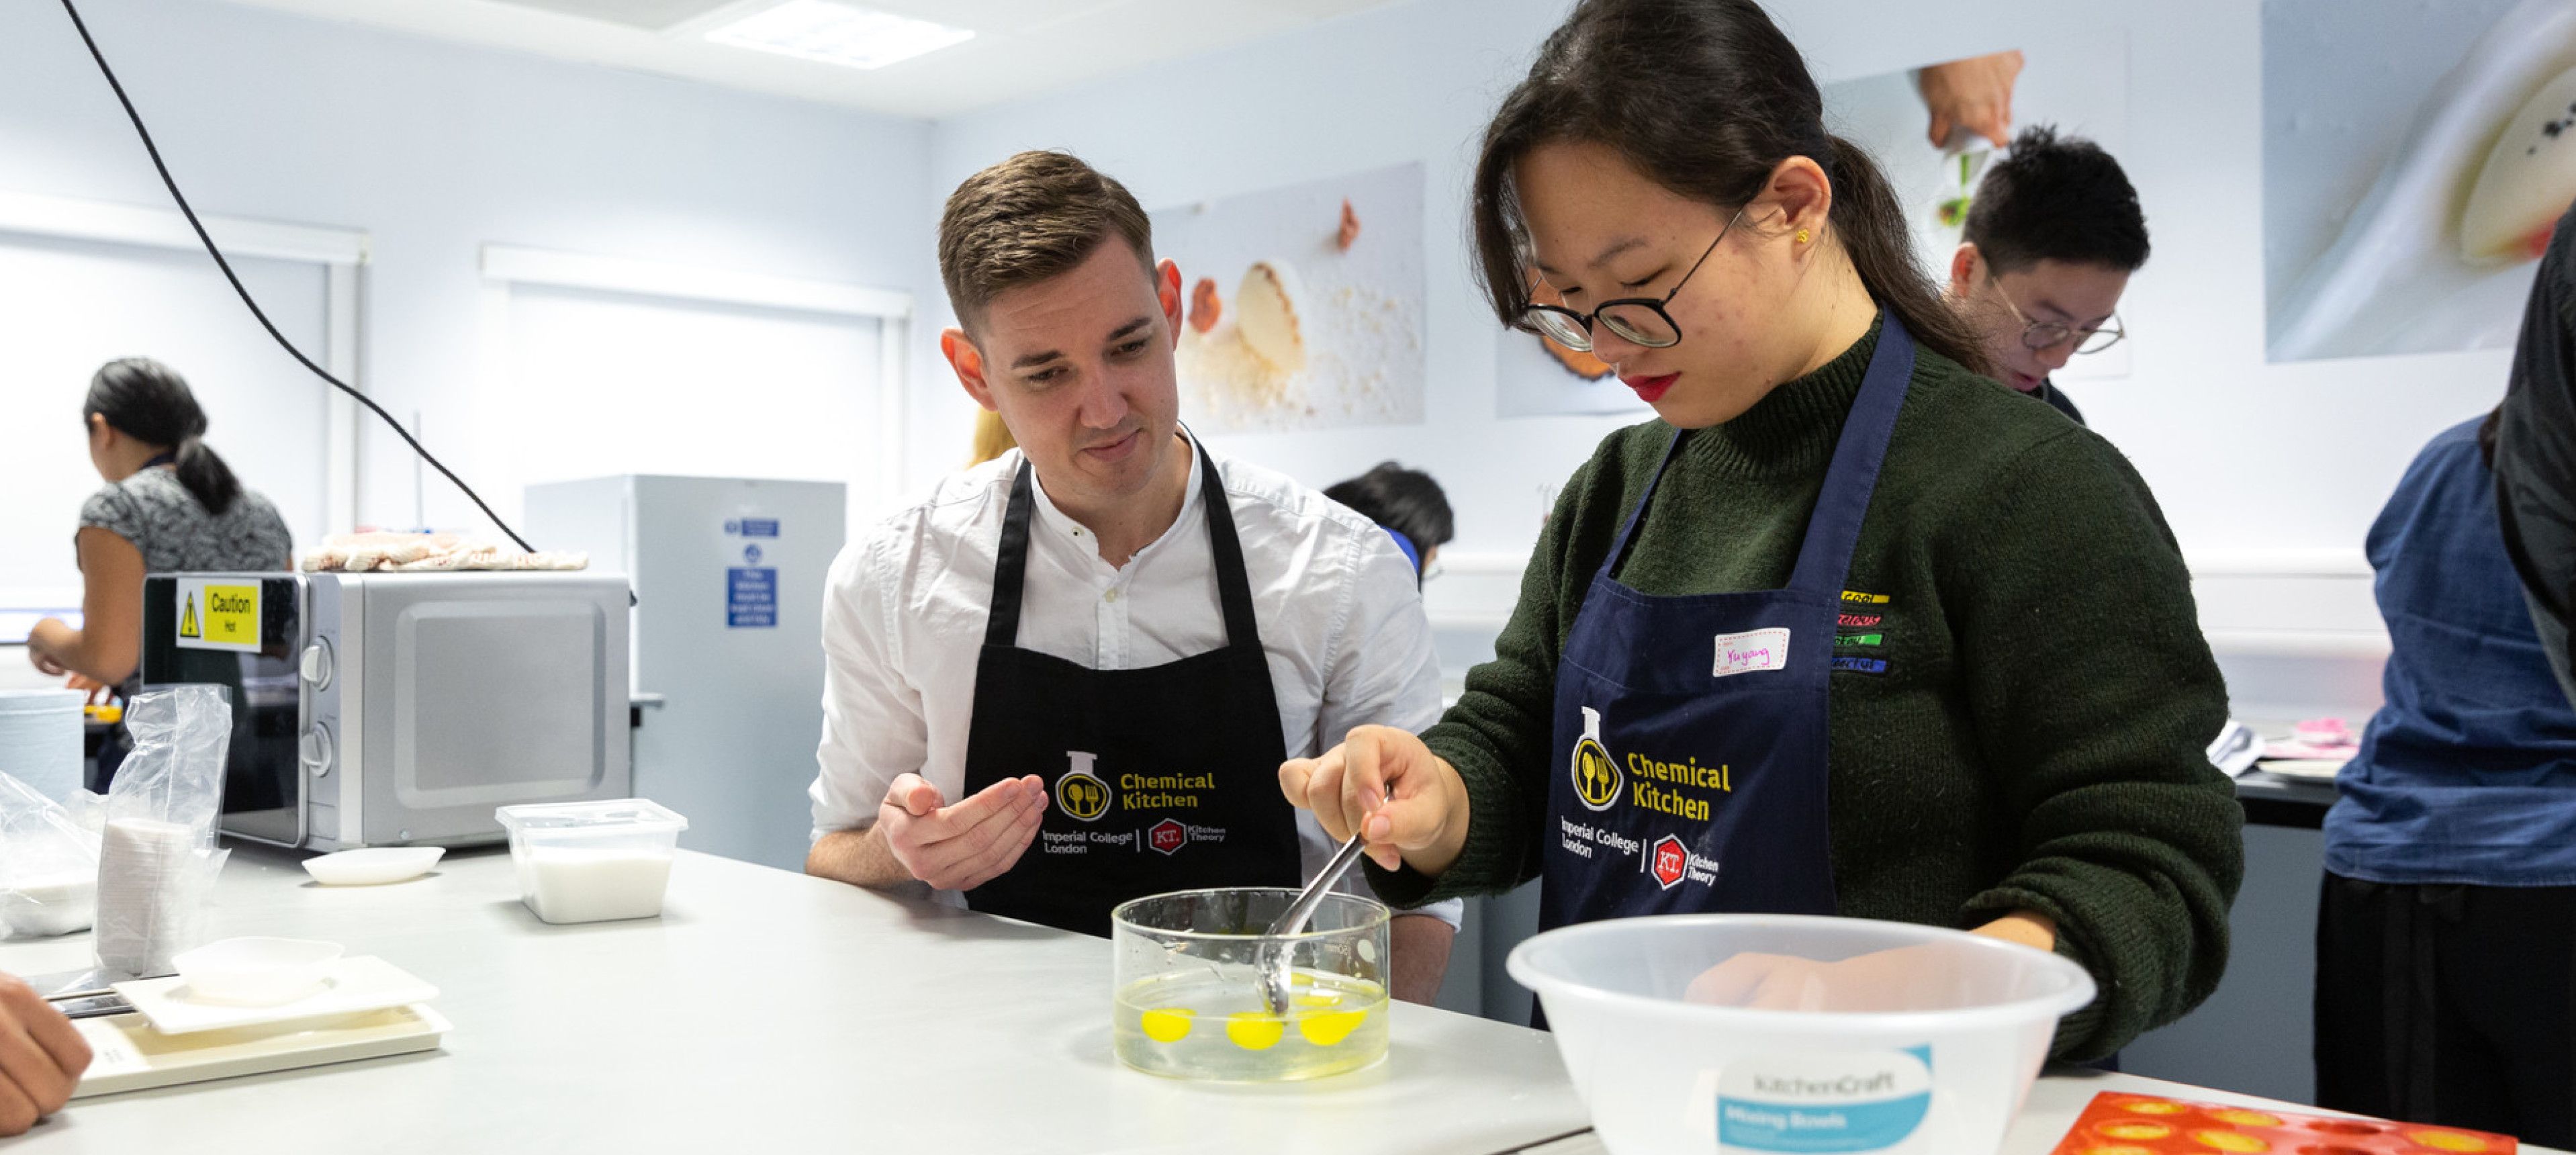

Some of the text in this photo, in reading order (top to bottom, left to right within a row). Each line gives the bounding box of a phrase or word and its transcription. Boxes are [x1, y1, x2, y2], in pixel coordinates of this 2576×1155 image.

[212, 592, 250, 614] Caution
[1120, 773, 1215, 790] Chemical
[1628, 753, 1731, 792] Chemical
[1123, 792, 1198, 810] Kitchen
[1633, 782, 1709, 821] Kitchen
[1043, 830, 1133, 845] Imperial College
[1188, 825, 1226, 834] Kitchen
[1191, 833, 1224, 841] Theory
[1044, 842, 1087, 854] London
[1561, 833, 1592, 858] London
[1596, 829, 1639, 856] College
[1690, 853, 1719, 872] Kitchen
[1688, 866, 1716, 886] Theory
